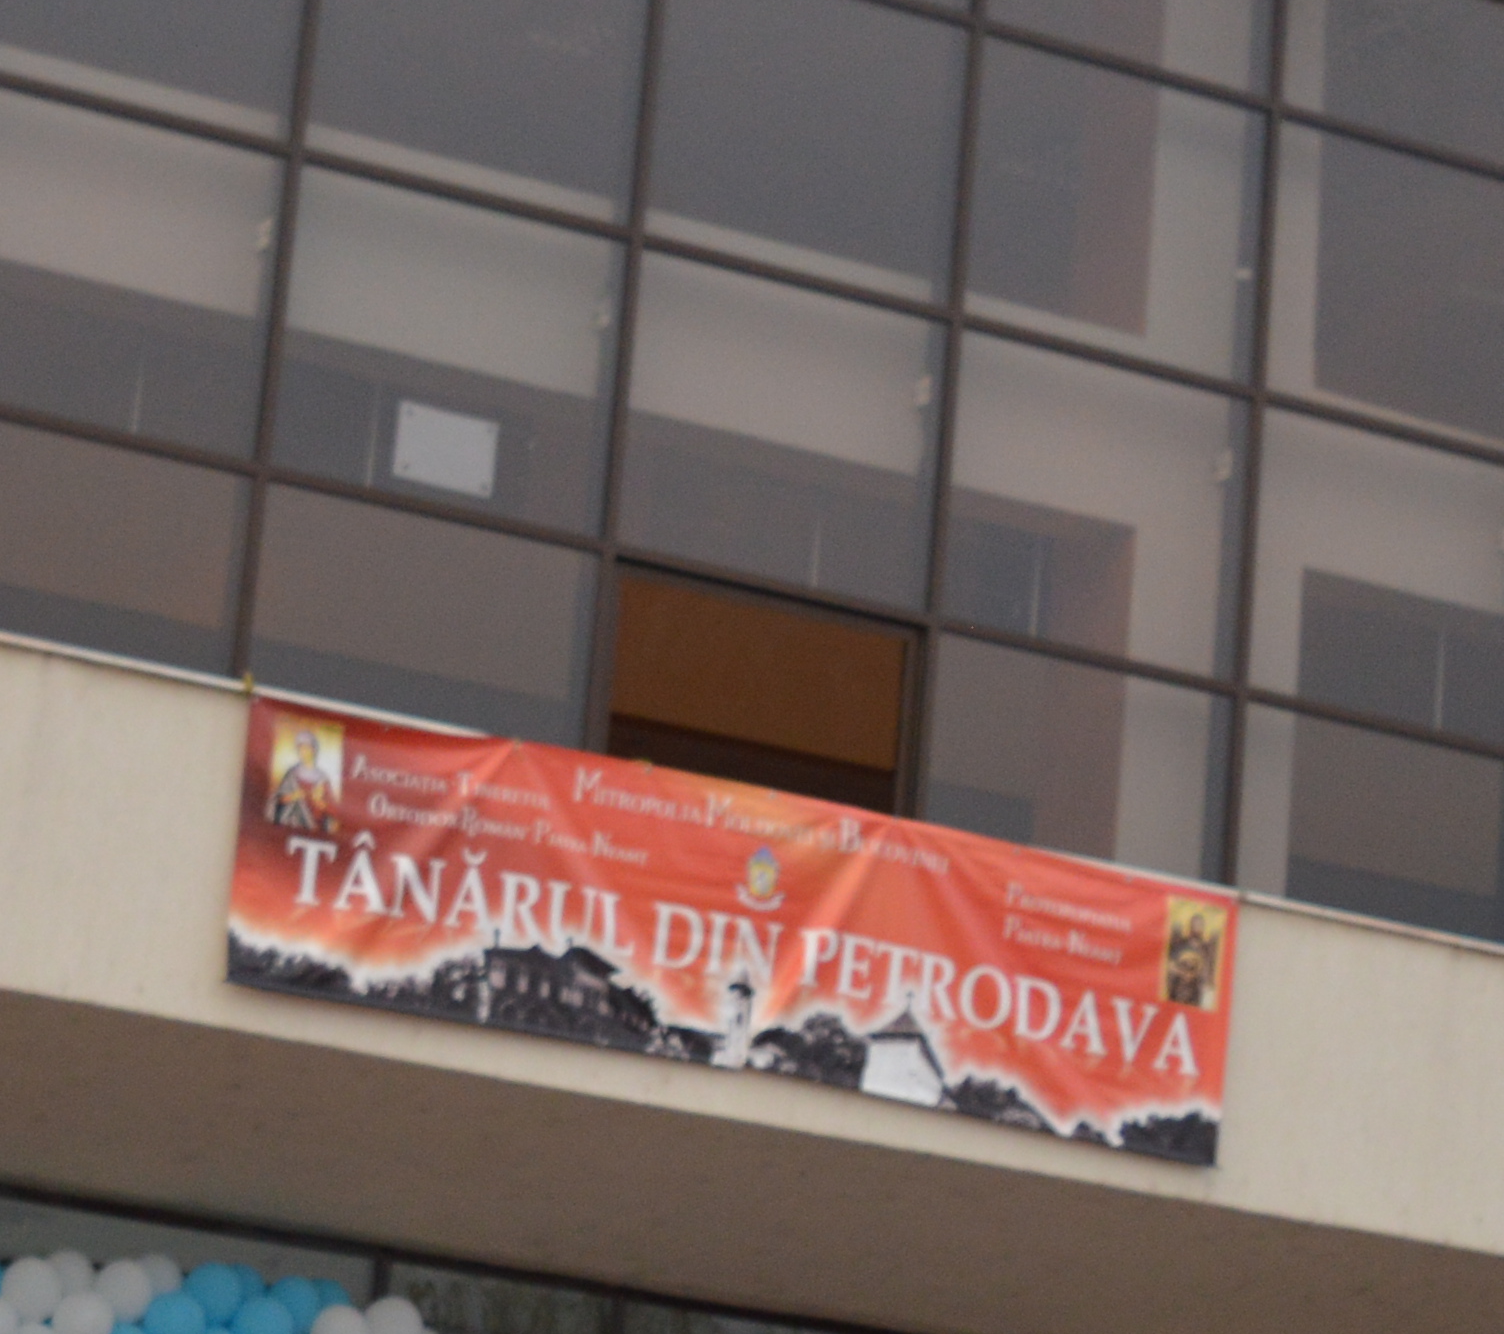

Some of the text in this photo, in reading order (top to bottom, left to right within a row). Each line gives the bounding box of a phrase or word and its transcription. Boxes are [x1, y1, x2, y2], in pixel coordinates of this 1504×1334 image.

[286, 829, 1200, 1077] TÂNĂRUL DIN PETRODAVA
